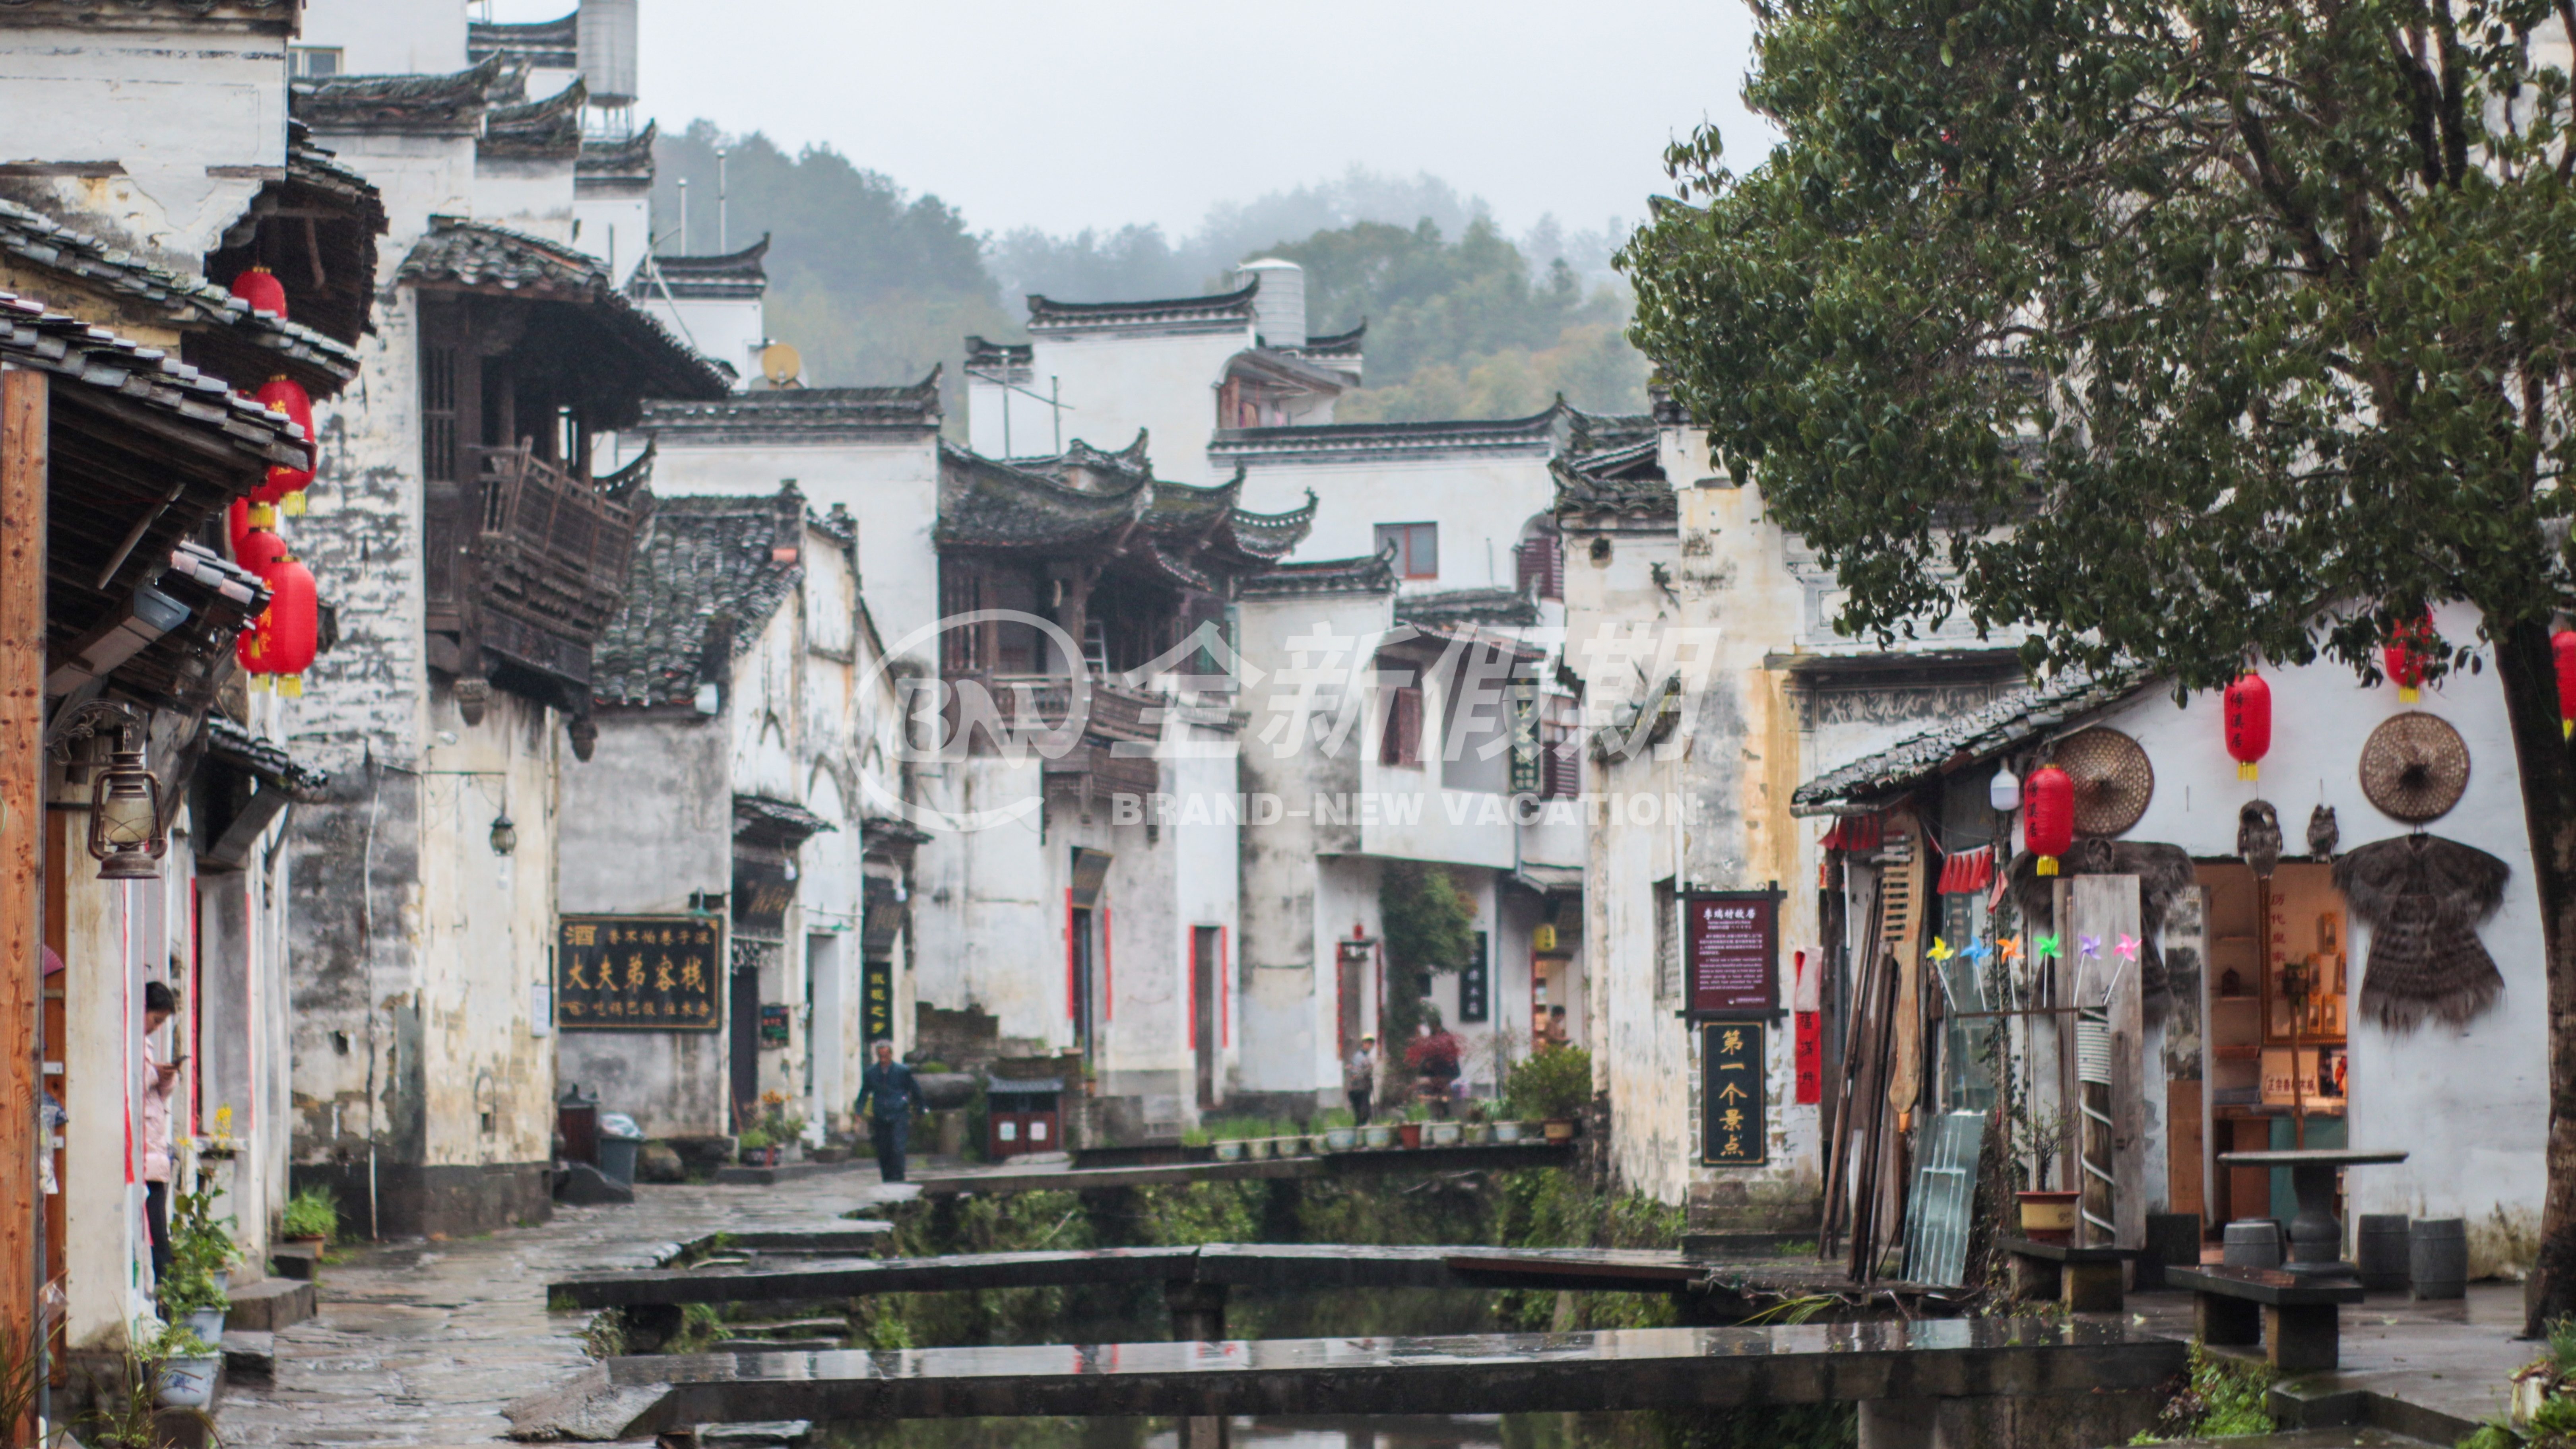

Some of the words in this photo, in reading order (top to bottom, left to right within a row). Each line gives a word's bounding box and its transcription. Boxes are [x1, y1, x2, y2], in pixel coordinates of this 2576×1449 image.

[1719, 1029, 1748, 1157] 第一个景点
[2268, 1079, 2314, 1092] 正宗香木梳
